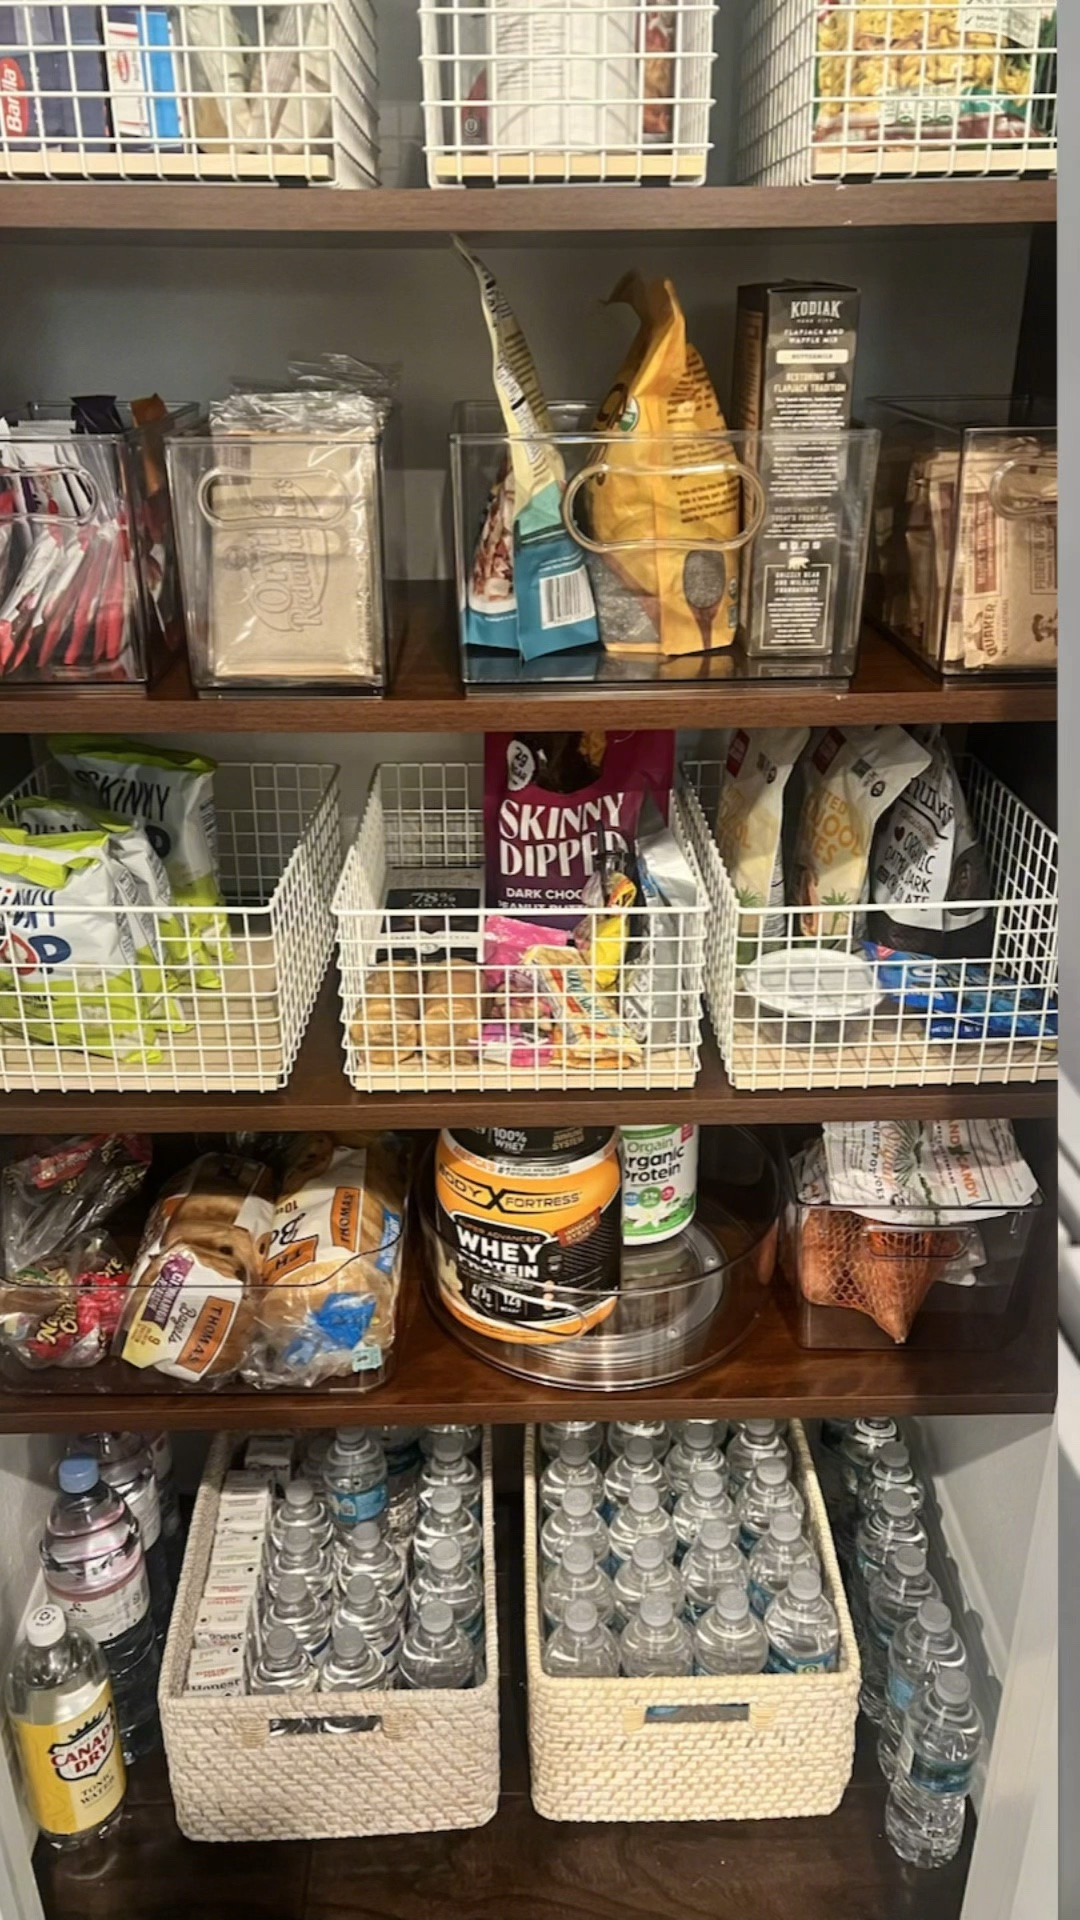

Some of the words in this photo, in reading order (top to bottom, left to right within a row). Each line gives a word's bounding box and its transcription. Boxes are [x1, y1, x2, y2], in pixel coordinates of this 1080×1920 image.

[1, 67, 23, 133] Barlla
[790, 300, 842, 319] KODIAK
[826, 328, 844, 336] AND
[984, 604, 998, 657] QUAKER
[500, 793, 624, 841] SKINNY
[411, 892, 456, 904] 78%
[506, 887, 541, 898] DARK
[545, 889, 585, 900] CHOC
[493, 1127, 527, 1142] 100%
[495, 1139, 525, 1151] WHEY
[627, 1138, 674, 1155] Orgain
[626, 1145, 685, 1170] rganic
[438, 1163, 483, 1199] BODY
[505, 1192, 580, 1208] FORTRESS
[956, 1156, 979, 1199] CANDY
[456, 1224, 543, 1264] WHEY
[168, 1302, 197, 1344] Bagels
[51, 1722, 112, 1769] CANAD
[75, 1743, 108, 1773] DRY
[80, 1775, 115, 1805] WATER
[82, 1771, 111, 1797] TONIC
